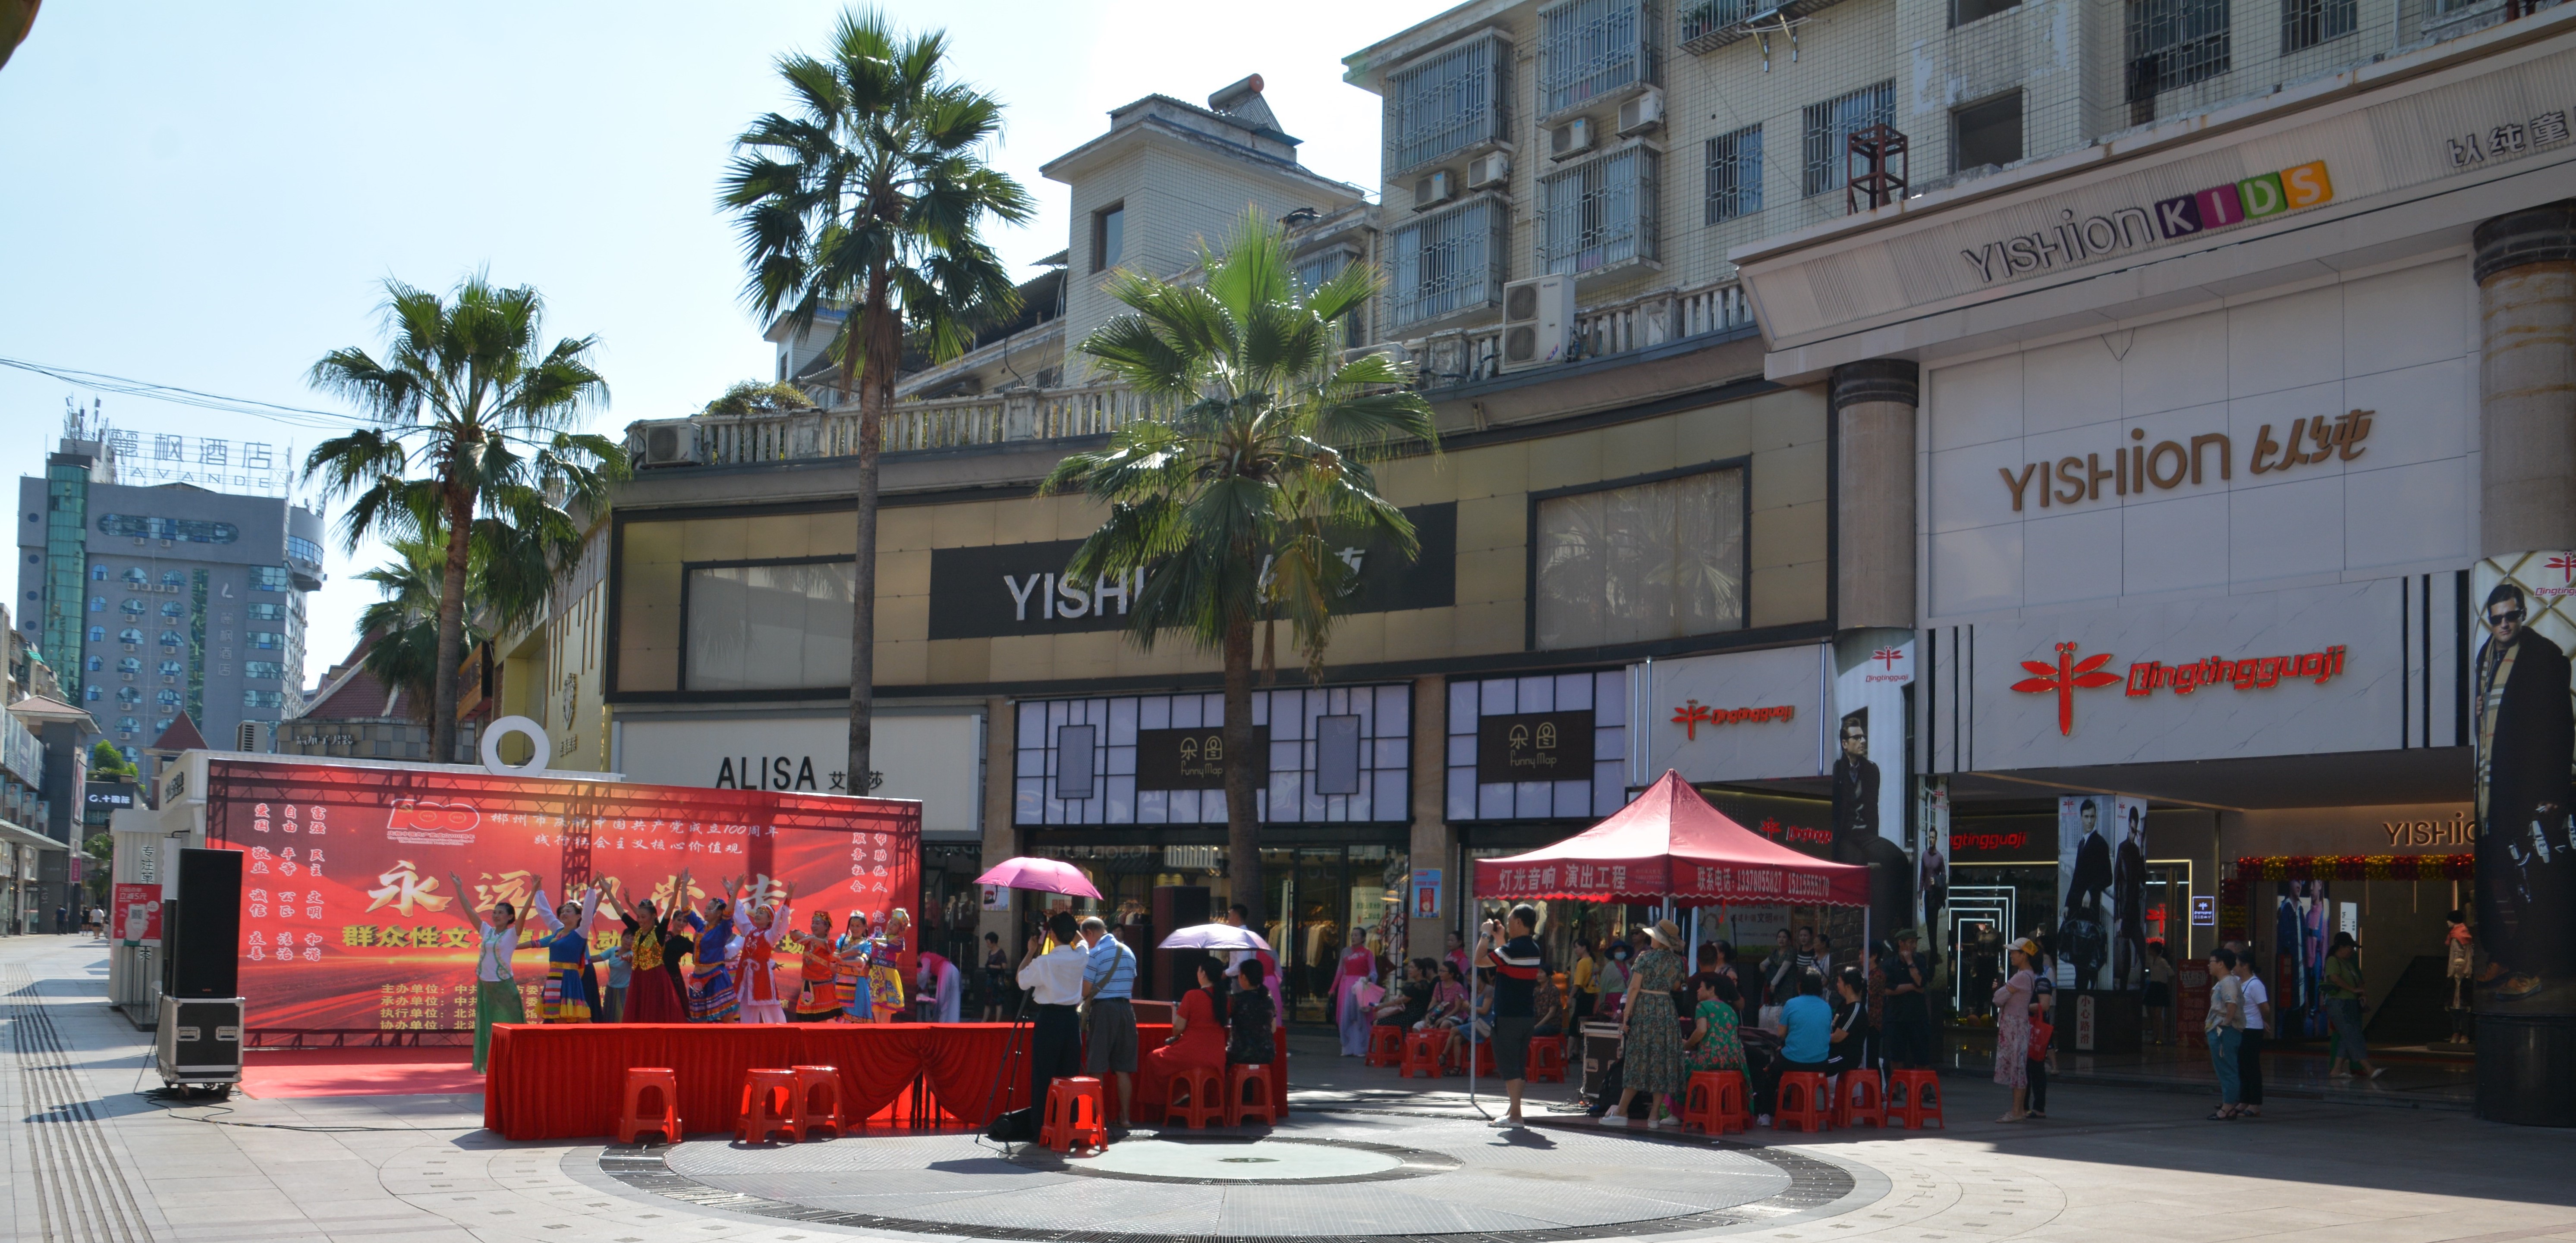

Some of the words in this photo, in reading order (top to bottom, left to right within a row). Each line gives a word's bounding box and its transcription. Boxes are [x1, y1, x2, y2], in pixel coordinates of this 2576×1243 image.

[2168, 174, 2321, 236] KIDS
[2534, 587, 2576, 597] Qingting
[716, 756, 817, 790] ALISA
[828, 771, 884, 790] 艾莎
[850, 832, 867, 892] 服务社会
[872, 832, 888, 892] 帮助他人
[1499, 866, 1556, 891] 灯光音响
[1564, 863, 1626, 889] 演出工程
